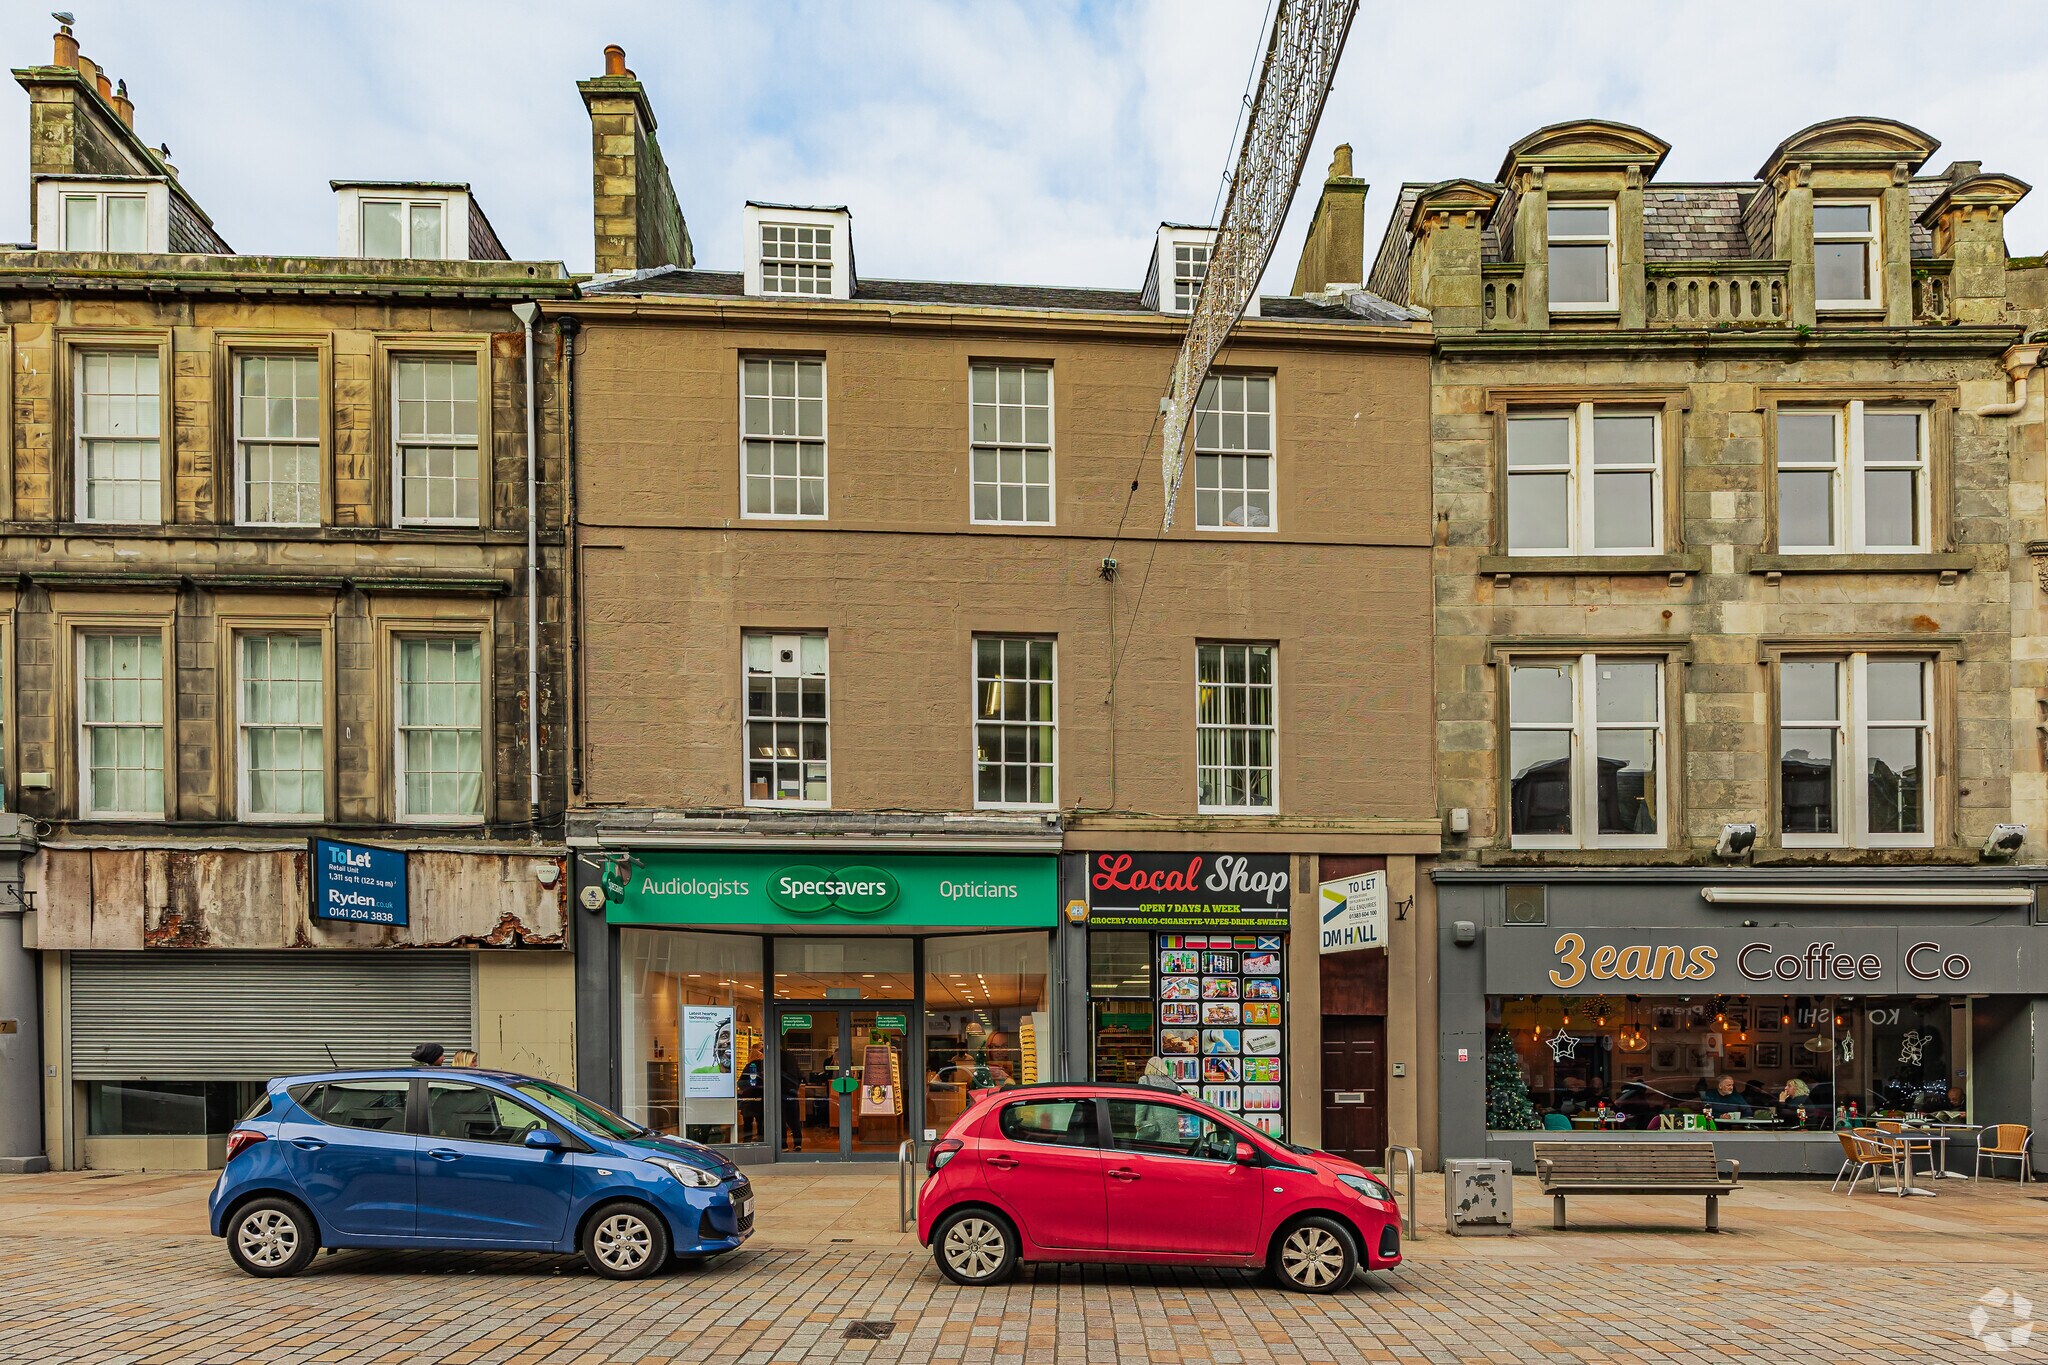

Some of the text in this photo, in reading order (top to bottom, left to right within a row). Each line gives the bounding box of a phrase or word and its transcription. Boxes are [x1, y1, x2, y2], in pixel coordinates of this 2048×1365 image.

[329, 846, 371, 868] ToLet
[361, 877, 374, 885] (122
[642, 878, 749, 898] Audiologists
[780, 877, 886, 898] Specsavers
[1092, 853, 1288, 904] Local Shop
[1349, 878, 1375, 893] TO LET
[940, 881, 1018, 901] Opticians
[330, 907, 393, 922] 0141 204 3838
[1139, 904, 1240, 913] OPEN 7 DAYS A WEEK
[1323, 924, 1377, 948] DM HALL
[1736, 942, 1882, 980] Coffee
[1904, 942, 1971, 980] Co
